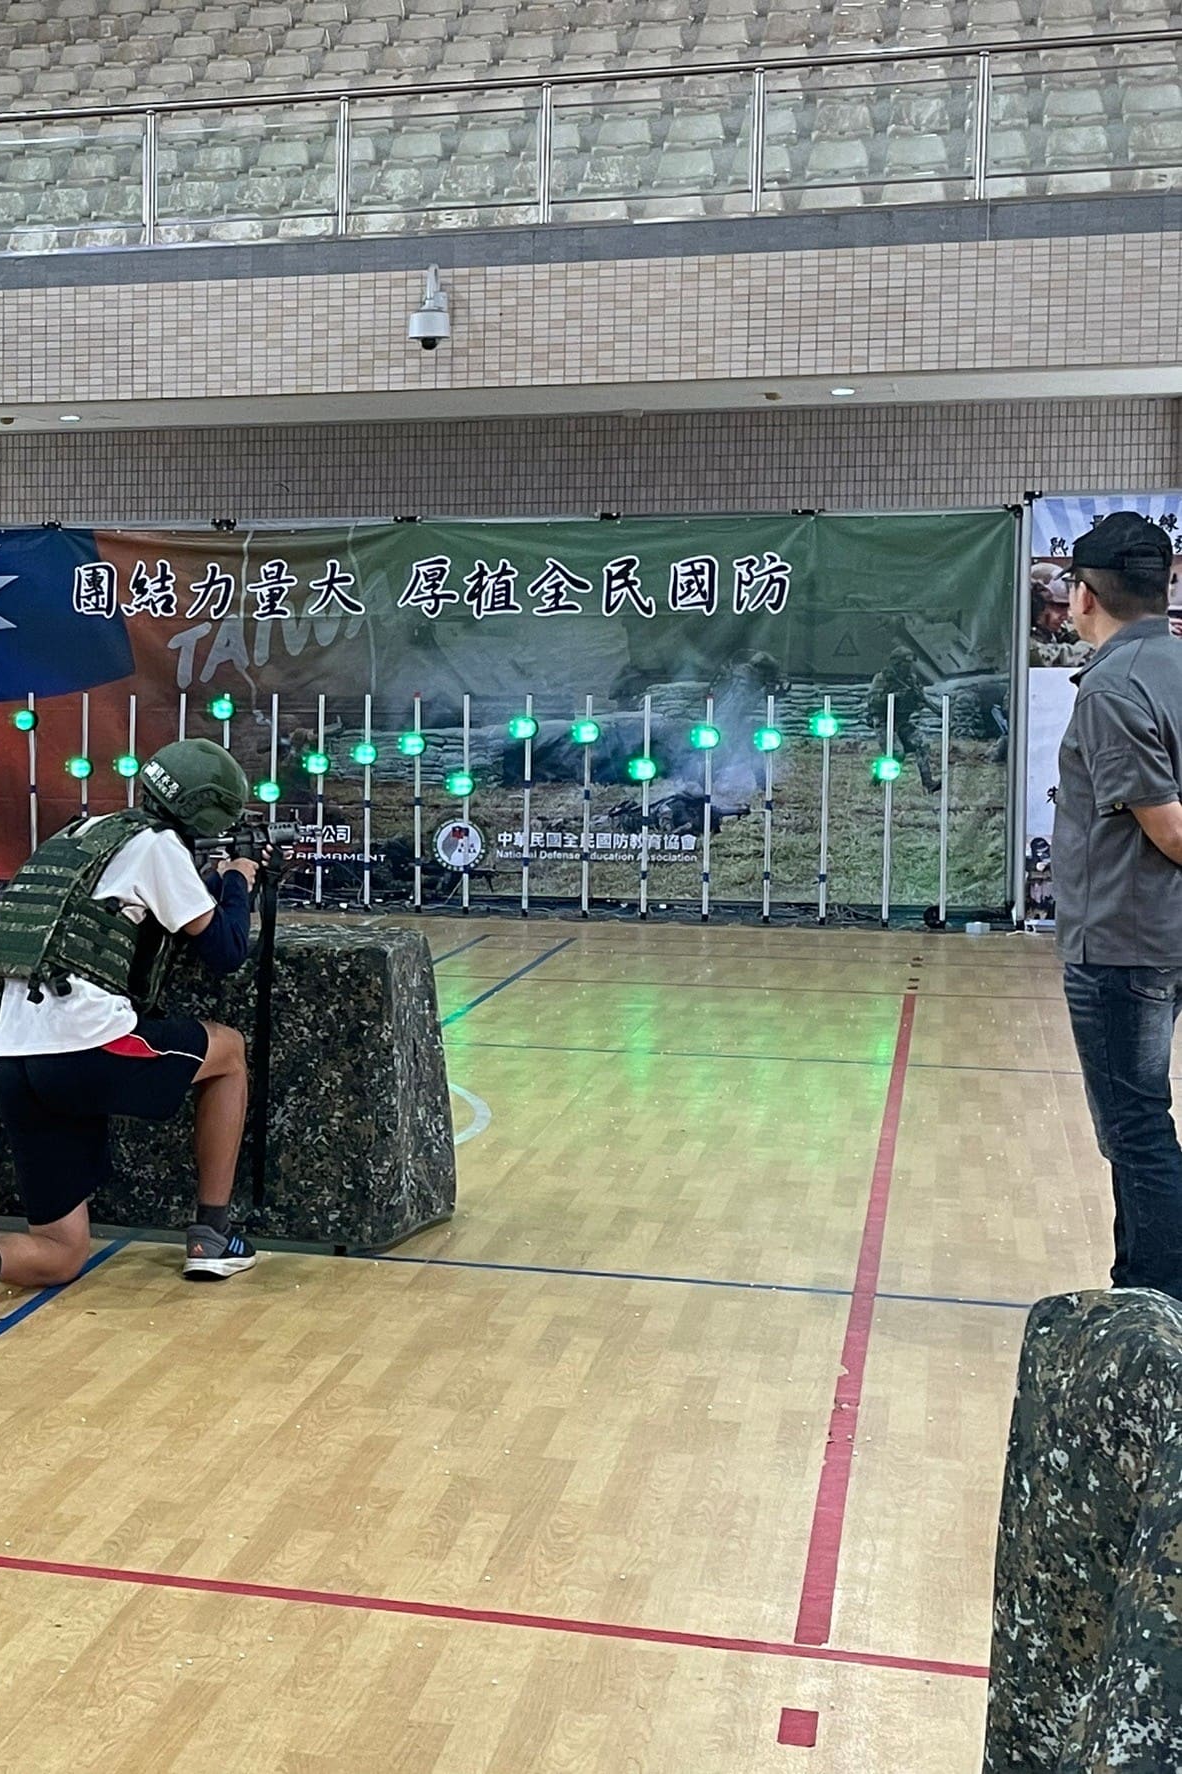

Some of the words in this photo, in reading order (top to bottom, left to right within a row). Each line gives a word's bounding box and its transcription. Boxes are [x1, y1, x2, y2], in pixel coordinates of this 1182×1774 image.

[72, 557, 365, 620] 團結力量大
[397, 553, 792, 619] 厚植全民國防
[496, 830, 698, 851] 中華民國全民國防教育協會
[496, 848, 537, 859] Natioal
[539, 850, 581, 860] Defense
[584, 850, 634, 861] ducation
[636, 852, 698, 862] Asociation
